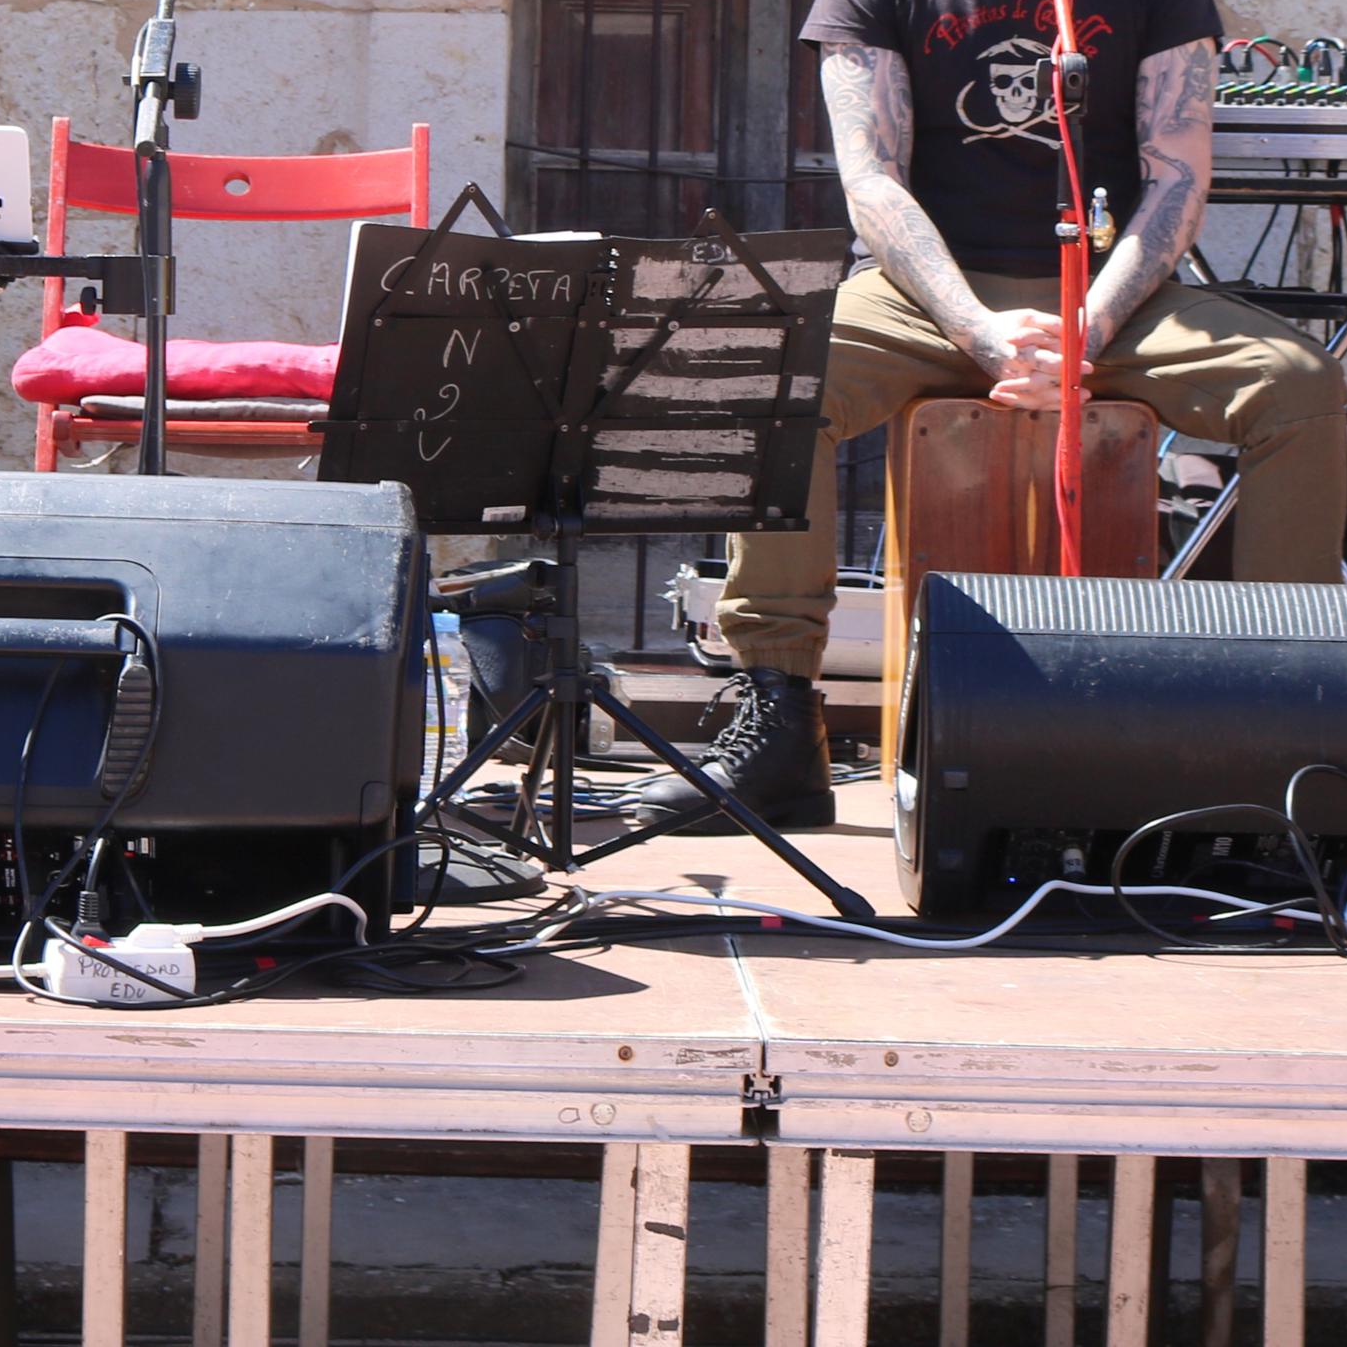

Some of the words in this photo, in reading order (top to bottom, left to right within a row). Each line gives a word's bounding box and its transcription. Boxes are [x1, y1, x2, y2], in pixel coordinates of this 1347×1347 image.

[924, 5, 1007, 54] Piratas
[1212, 836, 1233, 857] M10
[78, 955, 181, 979] PRODAD
[110, 982, 147, 999] EDU
